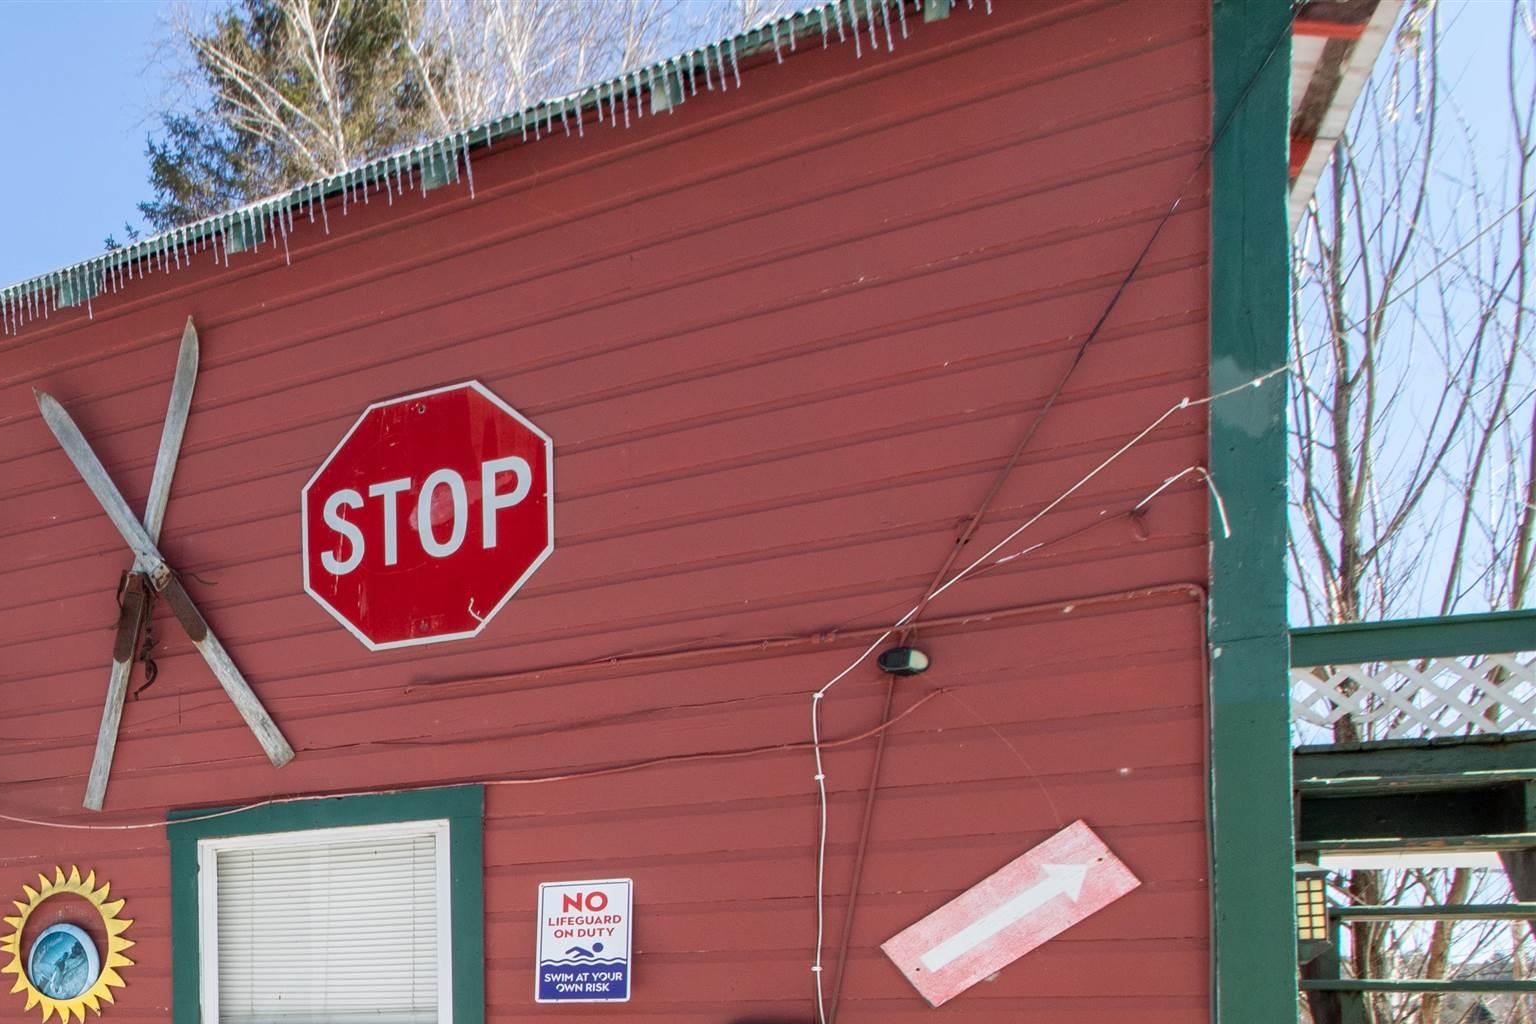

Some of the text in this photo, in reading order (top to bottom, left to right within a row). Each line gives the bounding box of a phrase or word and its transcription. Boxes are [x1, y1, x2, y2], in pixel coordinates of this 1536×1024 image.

[320, 455, 532, 576] STOP
[562, 891, 609, 913] NO
[548, 914, 622, 926] LIFEGUARD
[554, 927, 615, 938] ON DUTY
[544, 971, 623, 982] SWIM AT YOUR
[555, 982, 610, 992] OWN RISK
